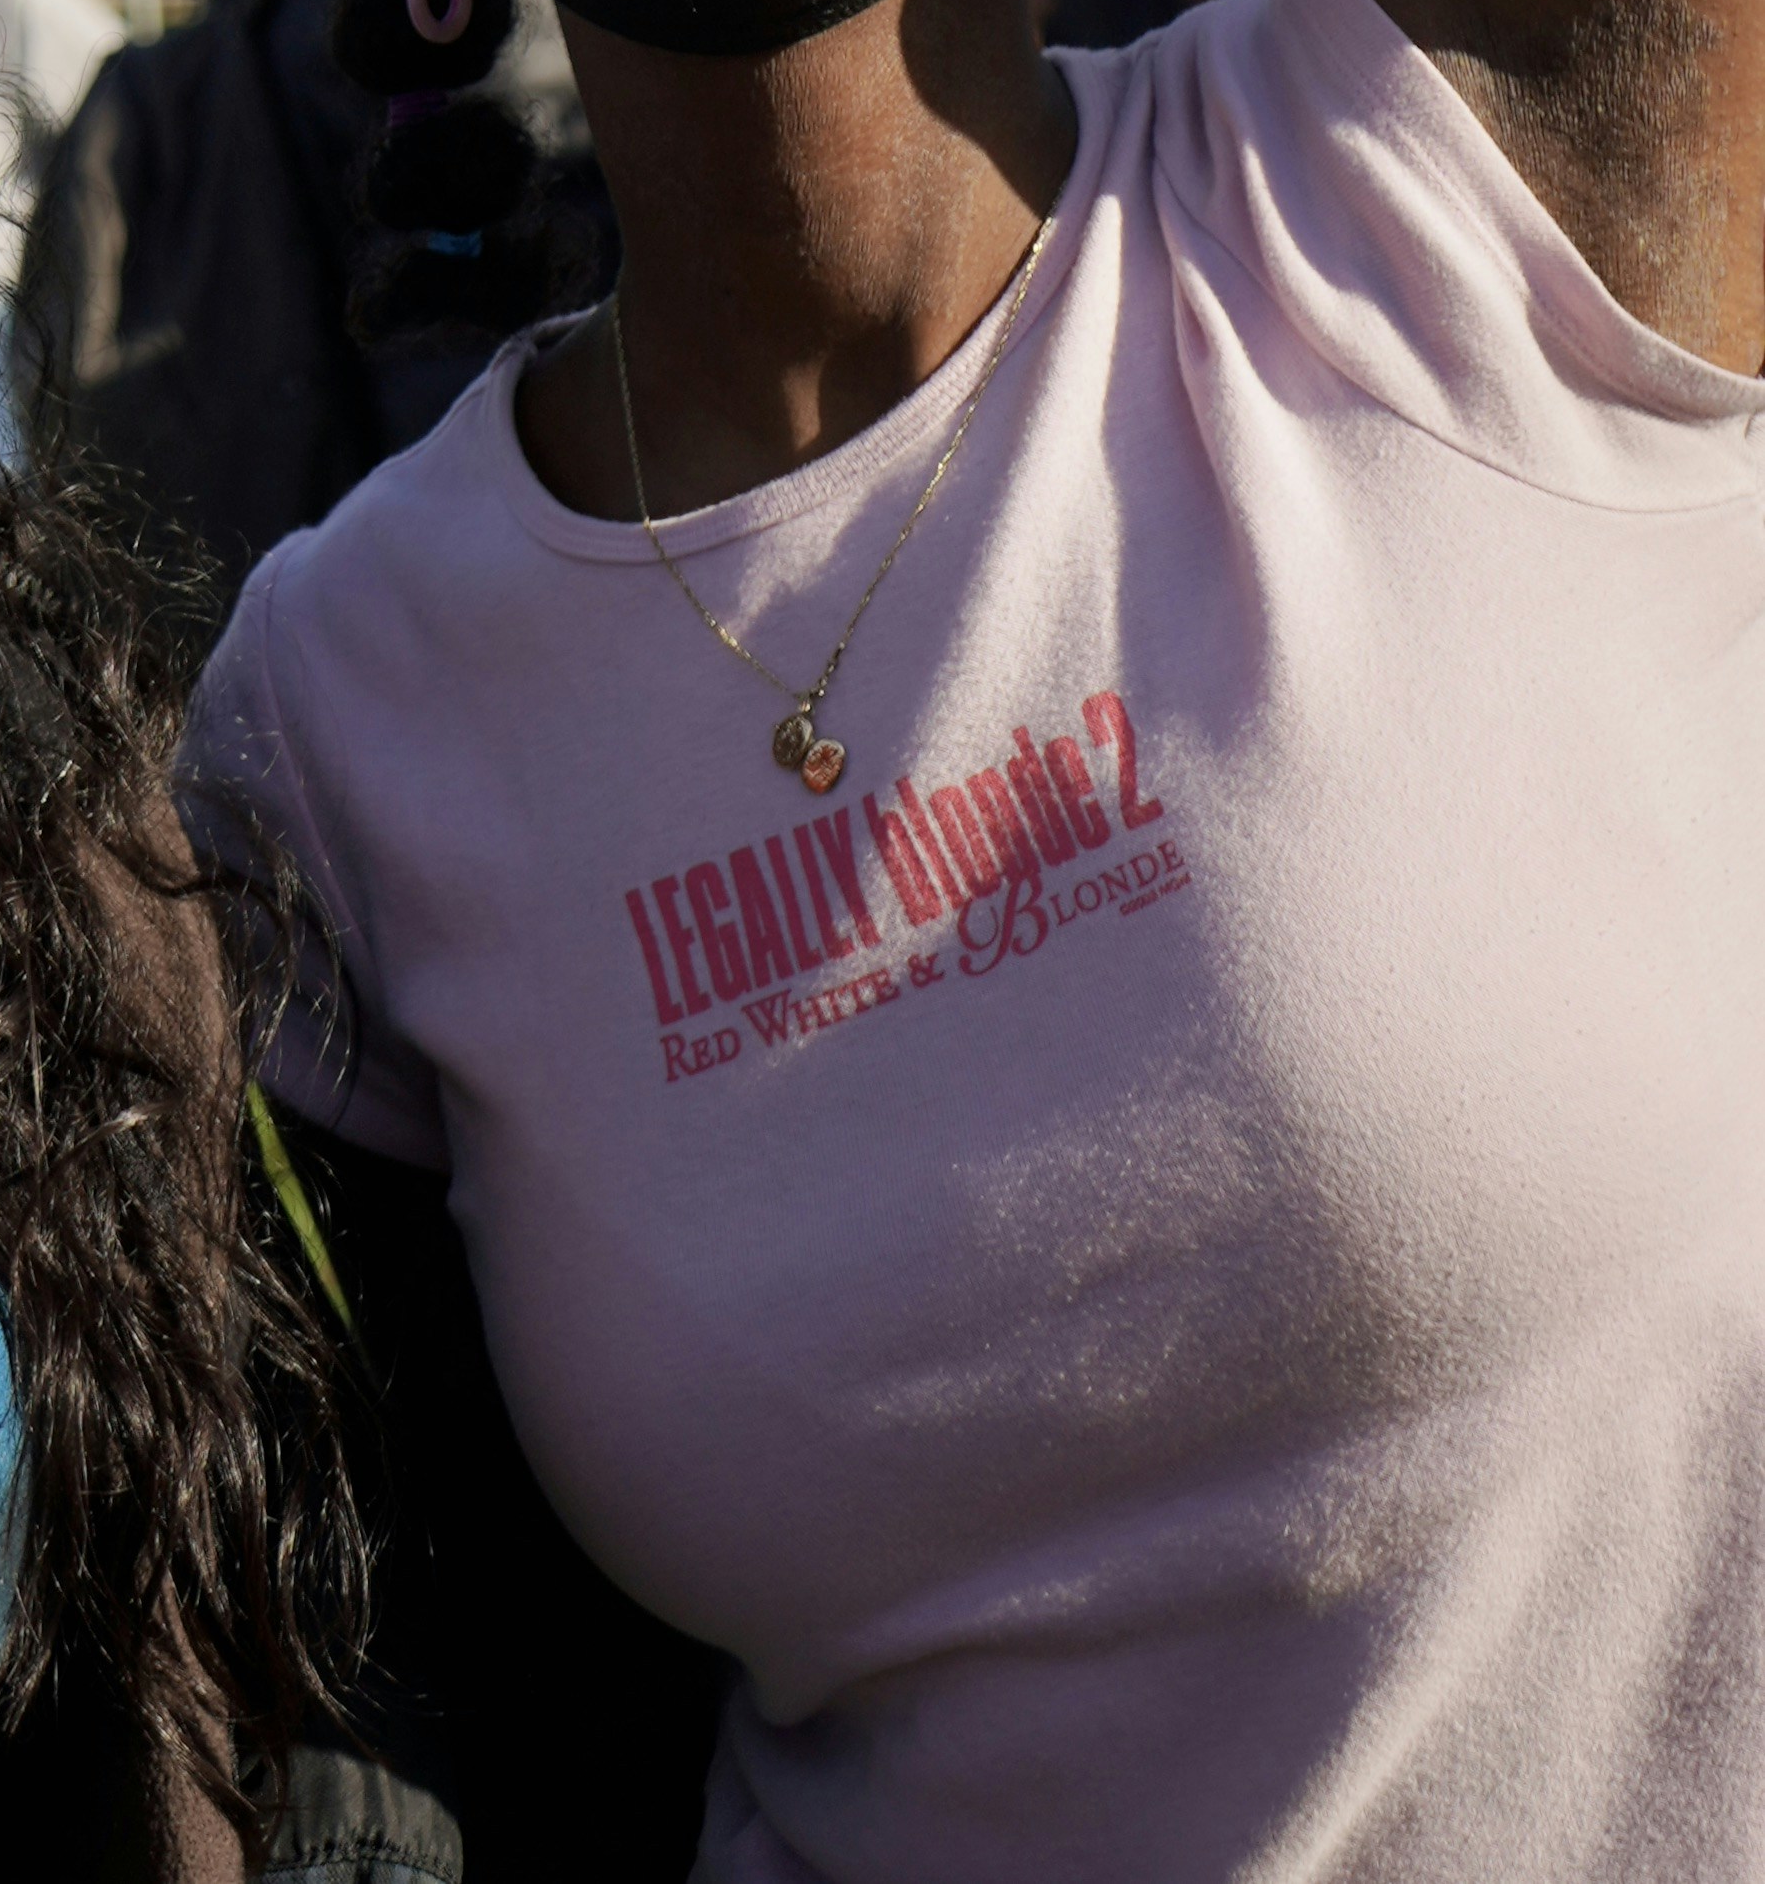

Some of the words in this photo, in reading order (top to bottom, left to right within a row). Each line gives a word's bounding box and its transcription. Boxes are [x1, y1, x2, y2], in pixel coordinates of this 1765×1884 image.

[625, 807, 883, 1026] LEGALLY
[864, 725, 1110, 928] blonde
[1083, 691, 1164, 830] 2
[908, 954, 945, 989] &
